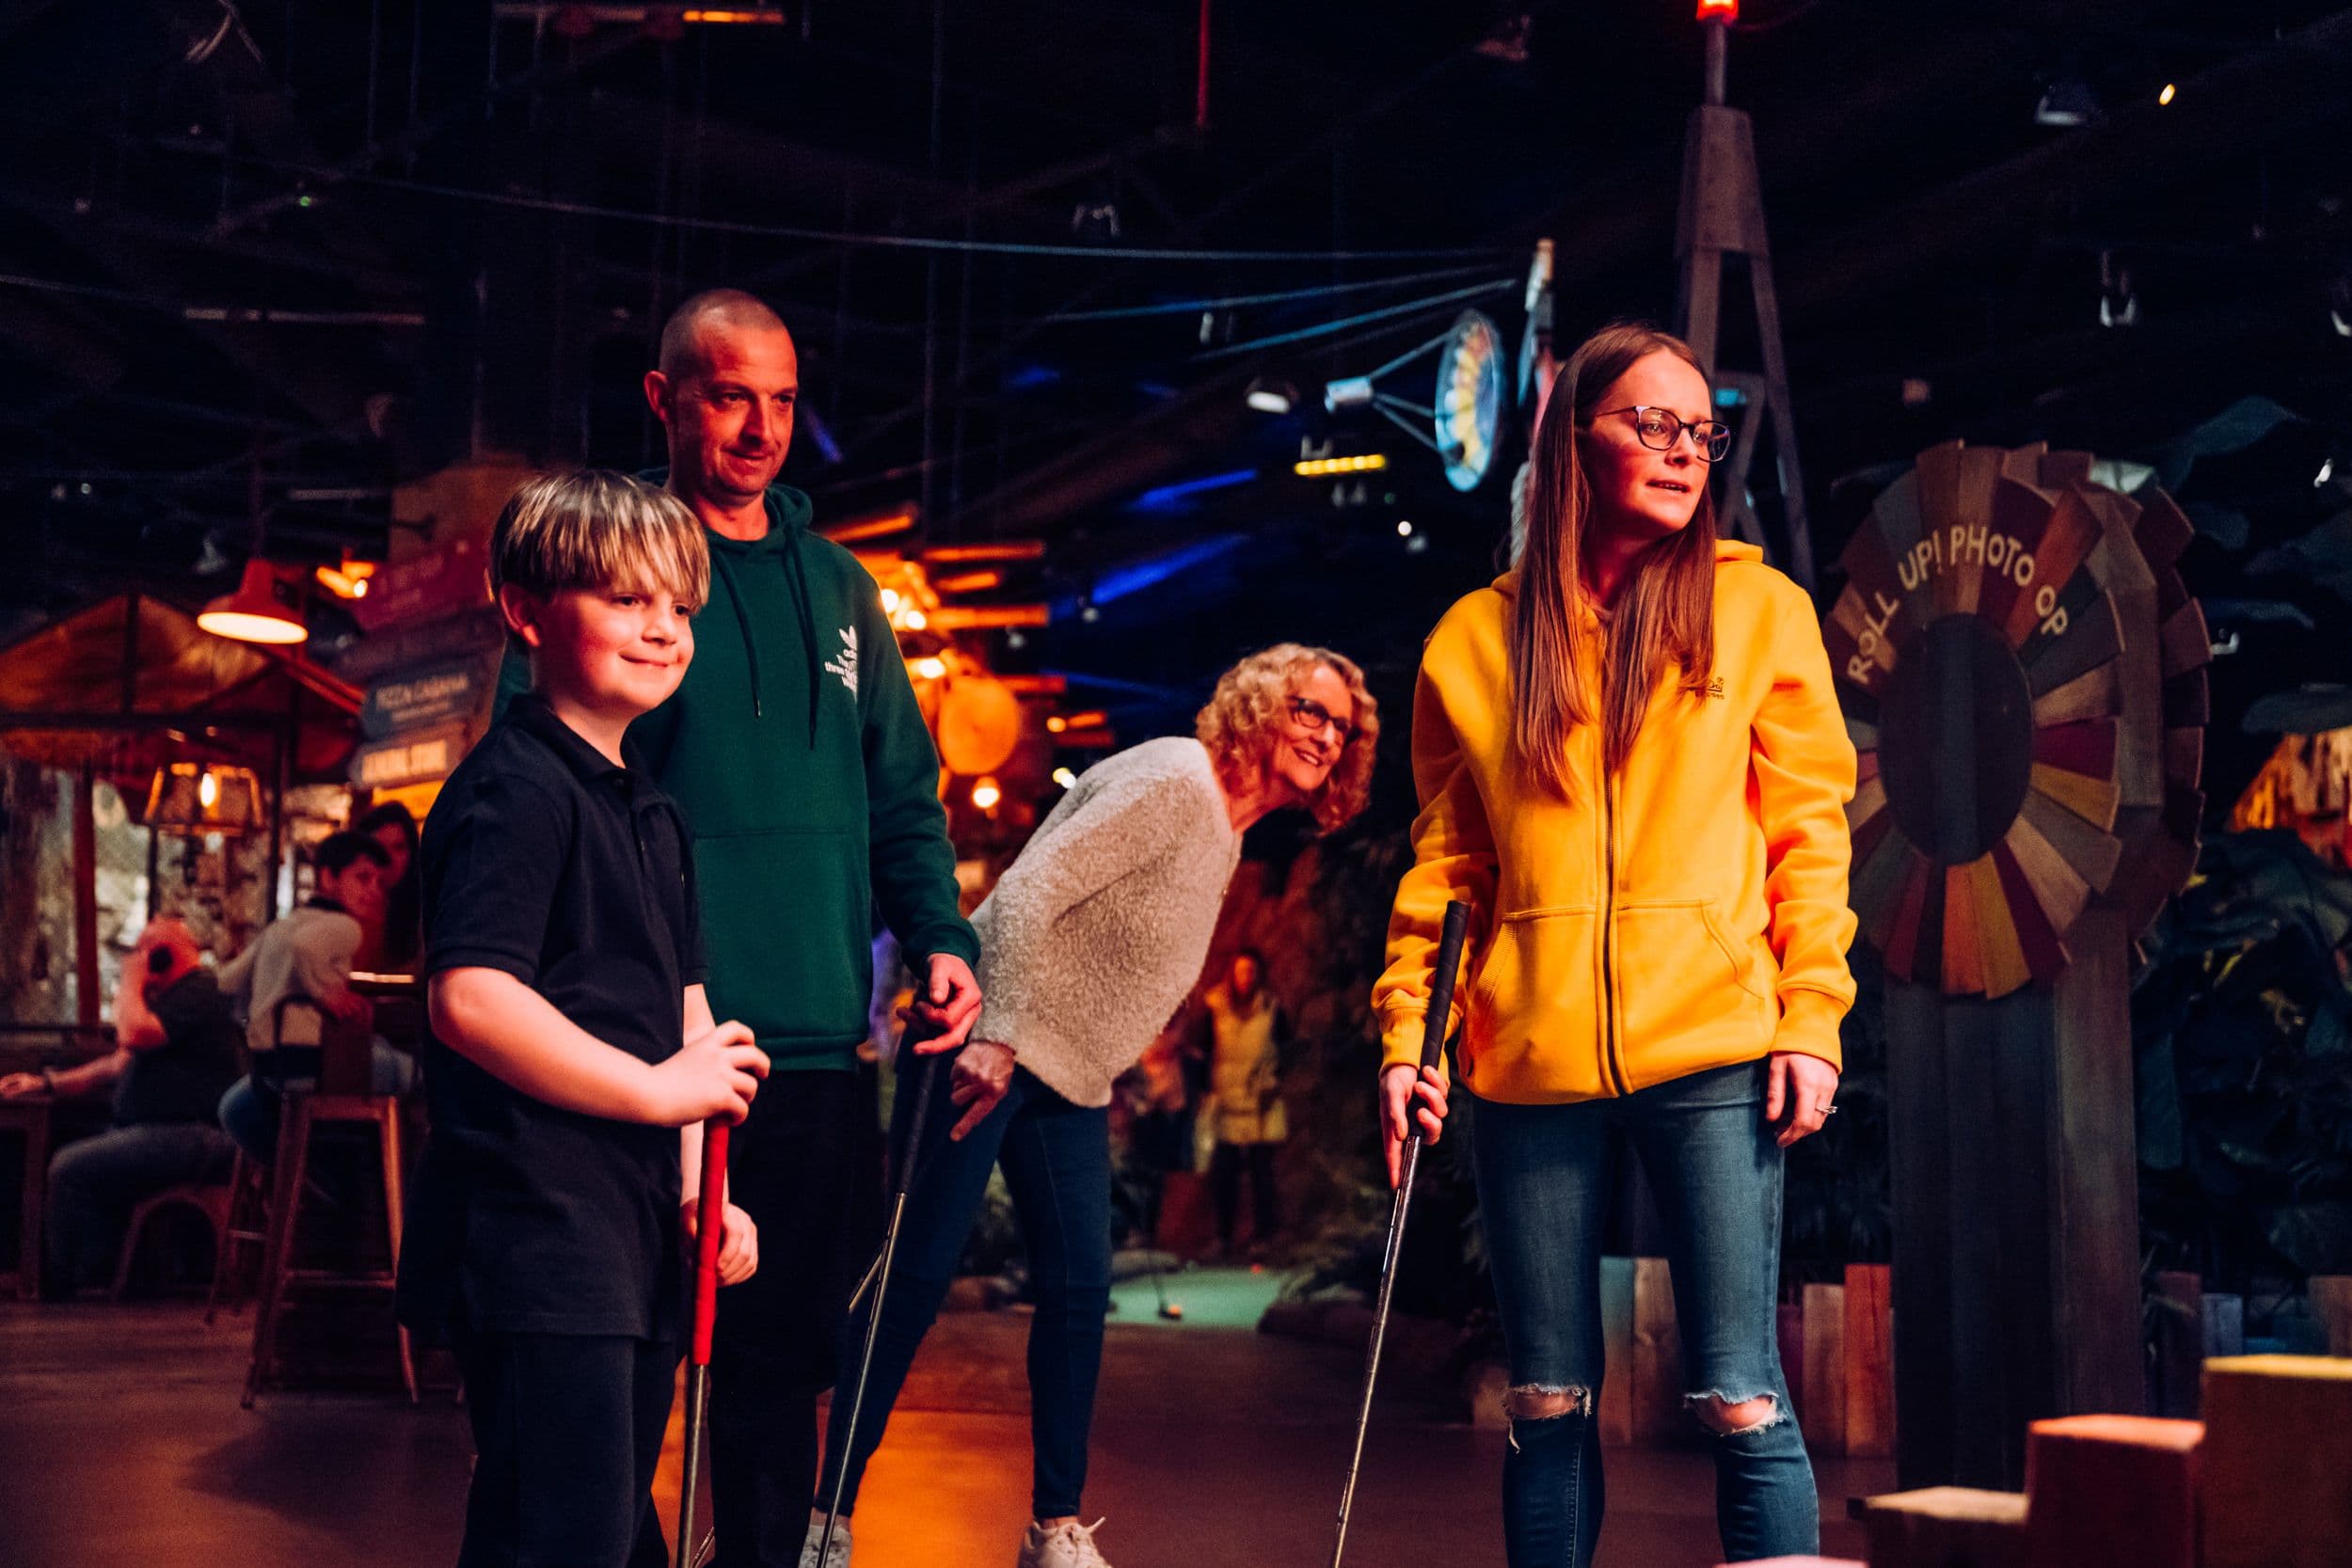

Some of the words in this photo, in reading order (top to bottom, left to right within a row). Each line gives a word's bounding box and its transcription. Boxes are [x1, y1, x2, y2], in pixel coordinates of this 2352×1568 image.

[1847, 592, 1899, 686] ROLL
[1898, 529, 1943, 592] UP!
[1949, 523, 2035, 587] PHOTO
[2035, 585, 2068, 636] OP
